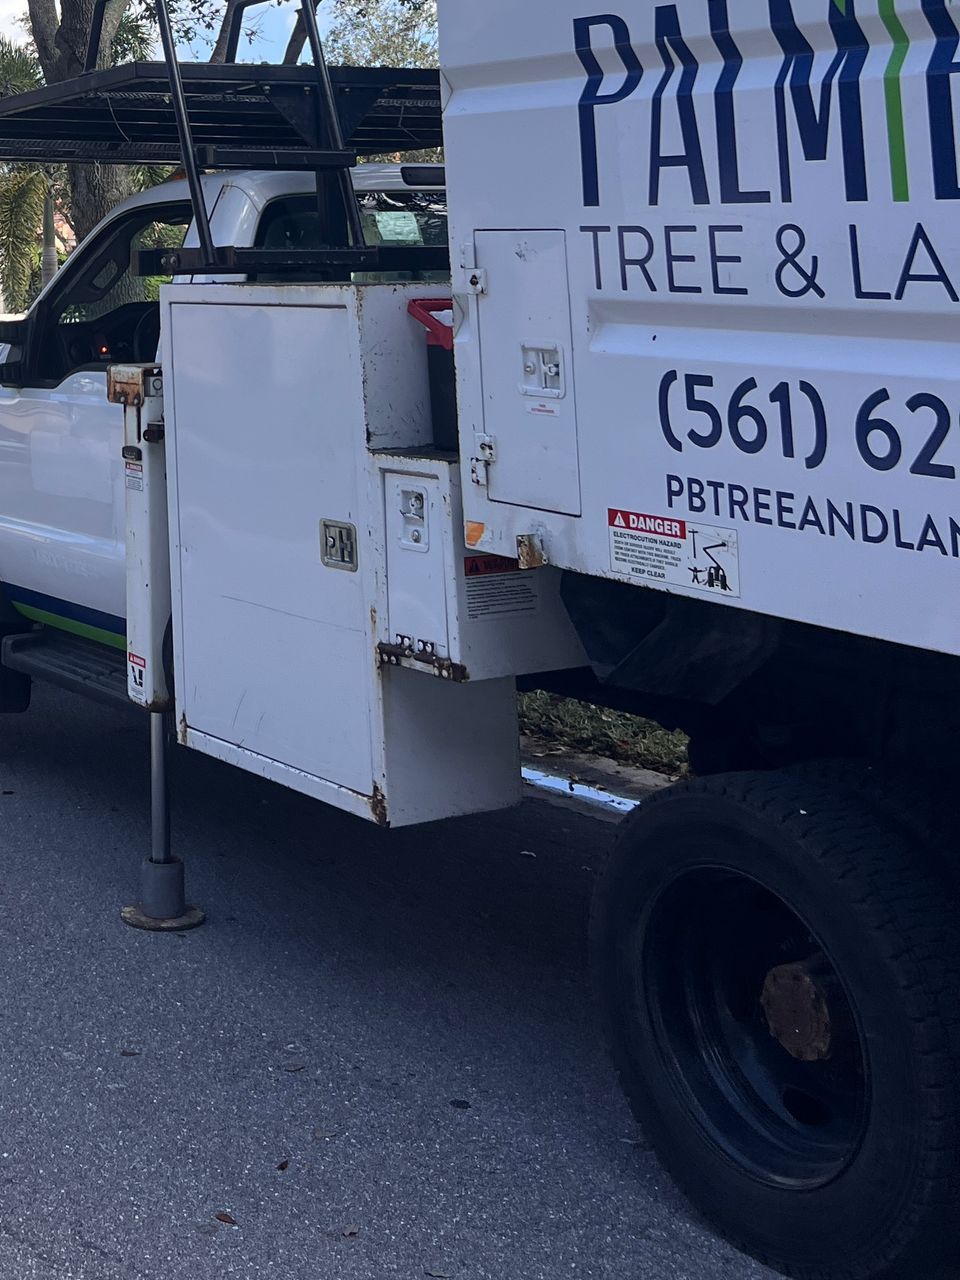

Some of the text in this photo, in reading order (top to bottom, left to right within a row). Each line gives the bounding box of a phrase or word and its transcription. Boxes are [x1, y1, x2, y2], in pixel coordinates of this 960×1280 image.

[579, 224, 749, 296] TREE
[774, 223, 826, 298] &
[658, 369, 960, 480] (561) 62
[629, 515, 680, 536] DANGER
[613, 531, 682, 549] ELECTROCUTION HAZARD
[631, 567, 666, 579] KEEP CLEAR
